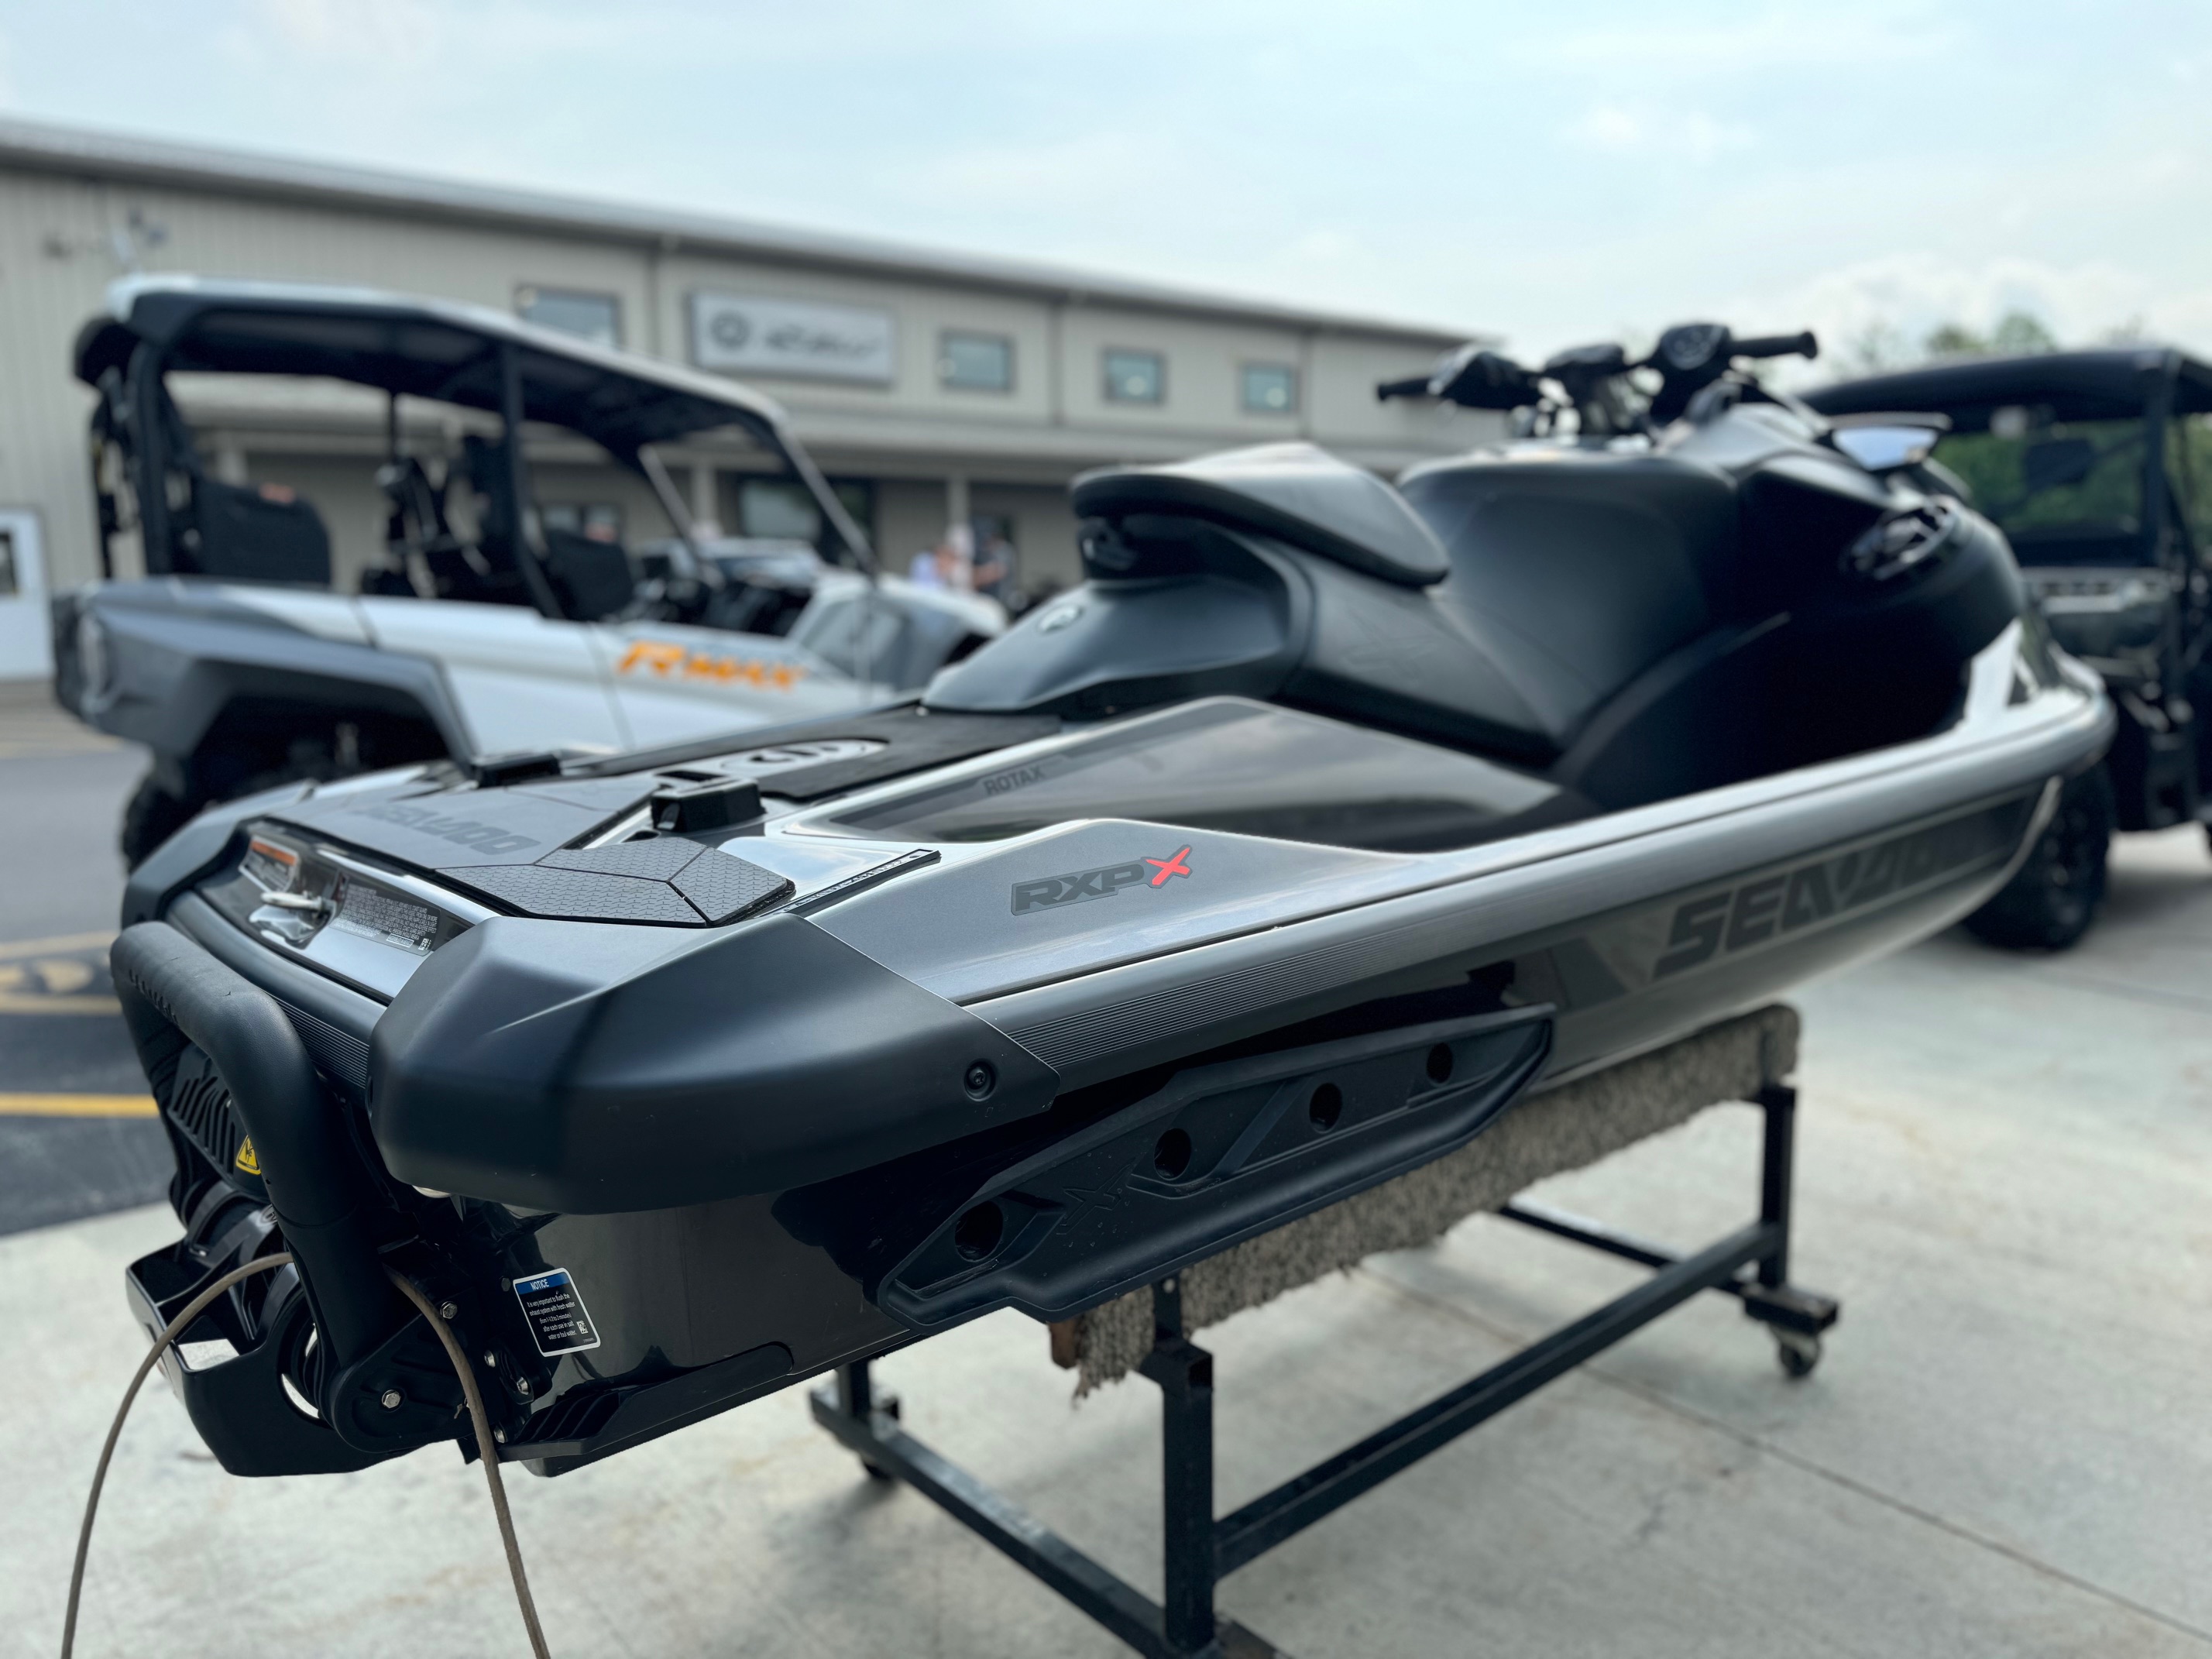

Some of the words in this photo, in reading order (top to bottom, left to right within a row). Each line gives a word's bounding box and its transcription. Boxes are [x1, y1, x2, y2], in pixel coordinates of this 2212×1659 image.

[982, 765, 1046, 795] ROTAX
[1650, 827, 1963, 981] SEADO
[531, 1279, 550, 1290] NOTICE
[538, 1297, 553, 1306] important
